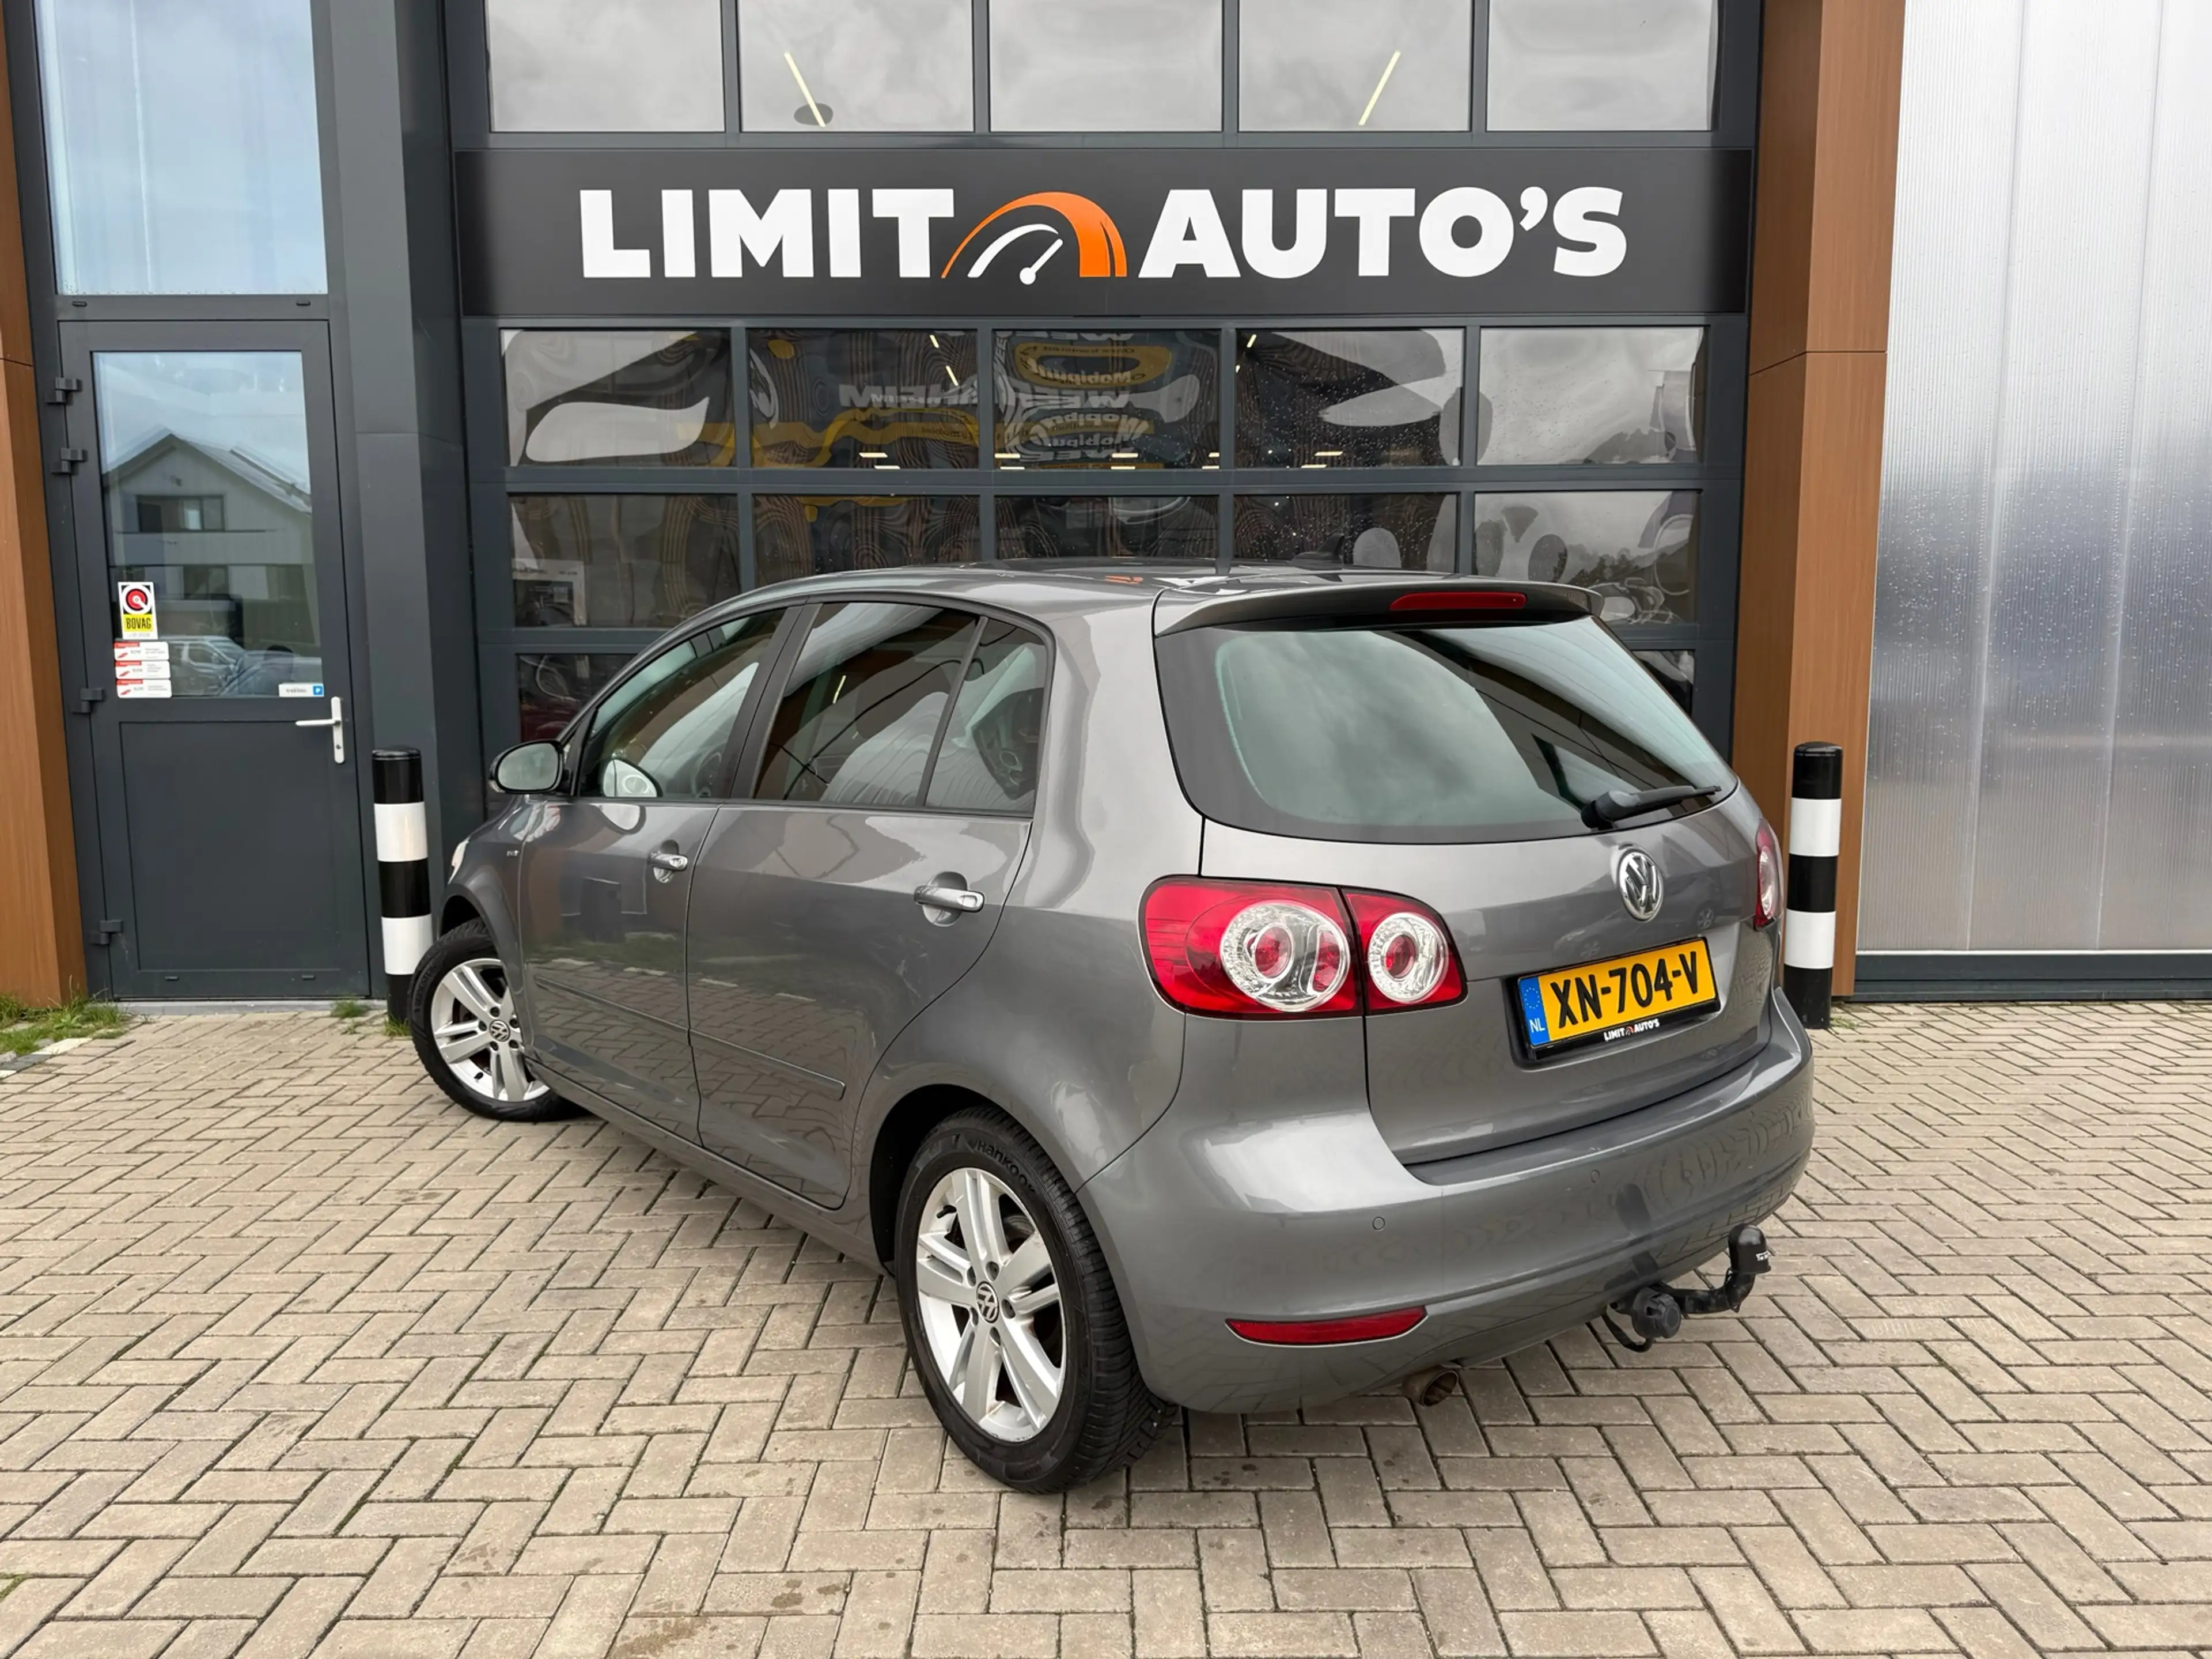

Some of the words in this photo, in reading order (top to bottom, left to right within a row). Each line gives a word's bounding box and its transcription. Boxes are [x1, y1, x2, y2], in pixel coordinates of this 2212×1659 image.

[579, 188, 955, 278] LIMIT
[1138, 186, 1627, 279] AUTO'S
[125, 617, 152, 630] BOVAG
[1550, 951, 1699, 1029] XN-704-V
[1529, 1017, 1546, 1033] NL
[1603, 1028, 1625, 1041] LIMIT
[1634, 1018, 1660, 1033] AUTO'S
